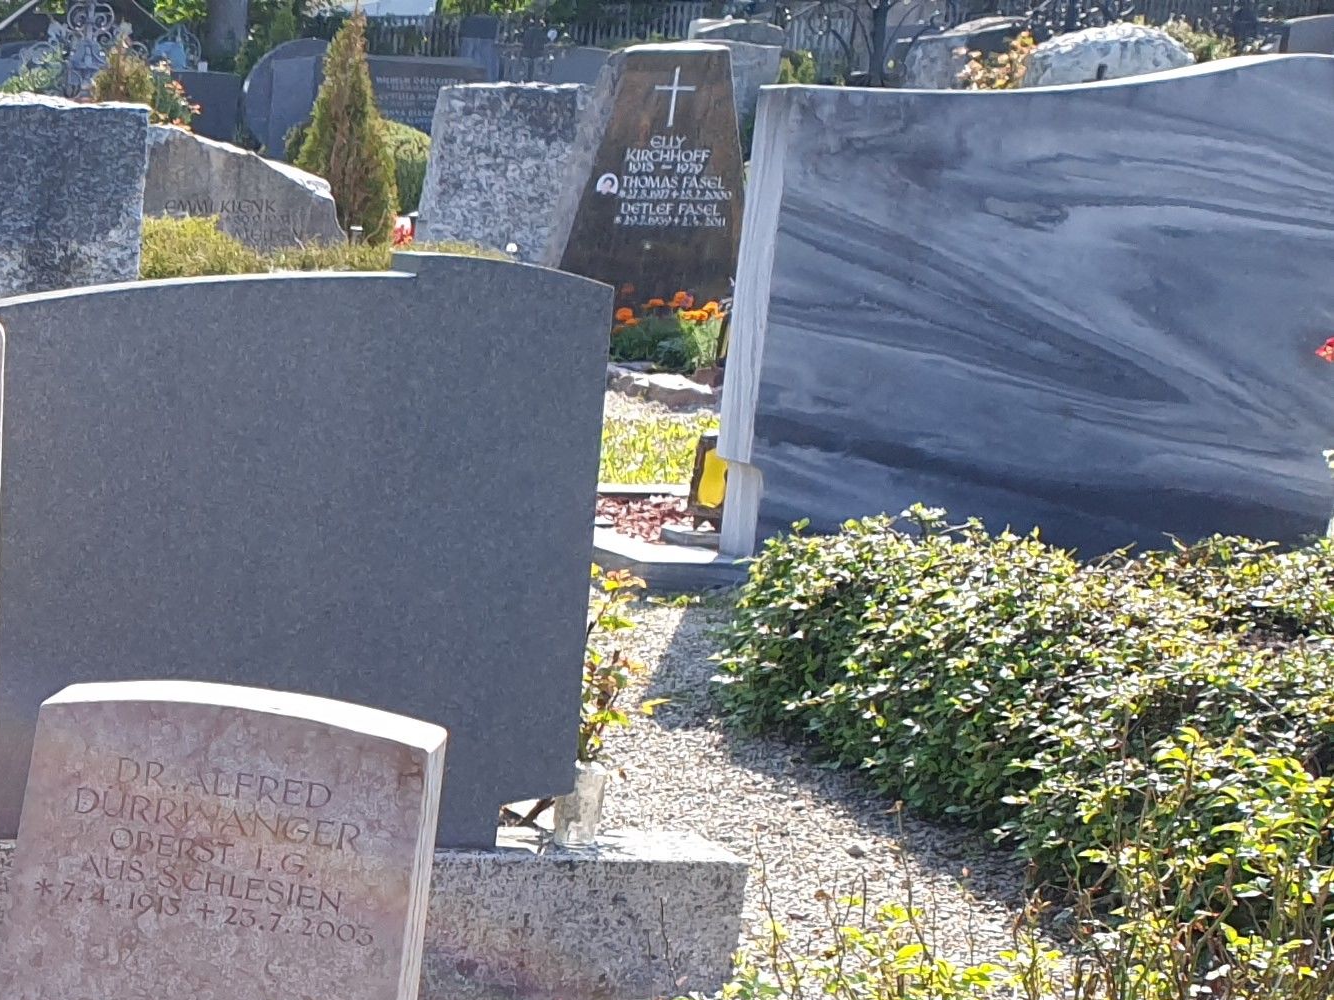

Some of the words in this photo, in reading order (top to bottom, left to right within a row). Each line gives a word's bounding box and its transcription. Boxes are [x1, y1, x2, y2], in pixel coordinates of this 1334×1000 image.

[625, 148, 711, 162] KIRCHHOFF
[650, 136, 687, 149] ELLY
[623, 175, 678, 188] THOMAS
[682, 175, 725, 189] FASEL
[621, 202, 674, 215] DETLEF
[678, 203, 721, 216] FASEL
[118, 757, 177, 790] DR.
[185, 768, 332, 809] ALFRED
[75, 783, 361, 852] DÜRRWANGER
[109, 827, 233, 865] OBERST
[84, 854, 145, 883] AUS
[158, 863, 343, 914] SCHLESIEN
